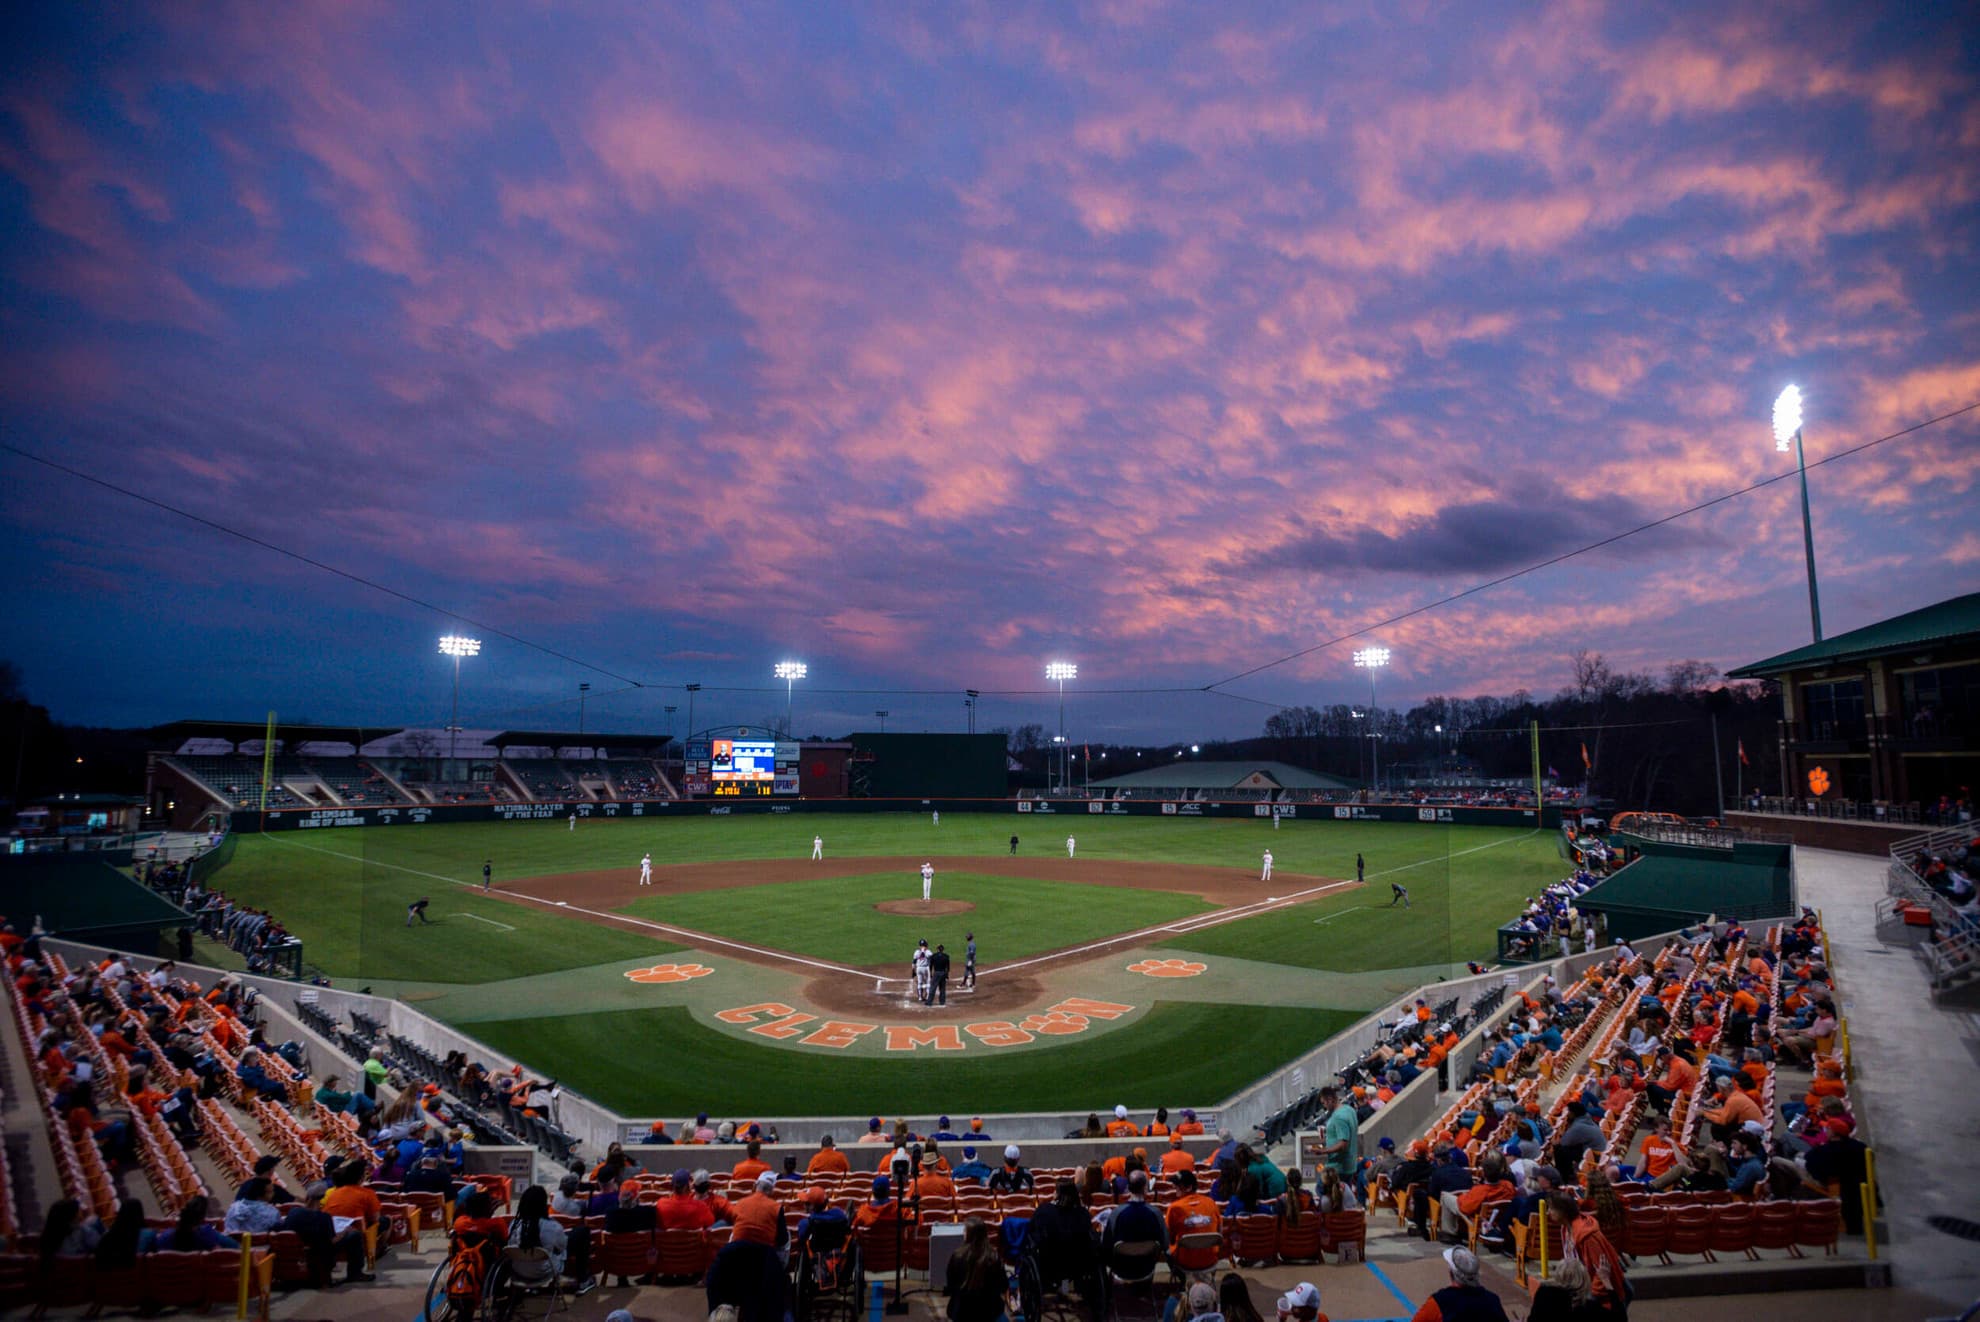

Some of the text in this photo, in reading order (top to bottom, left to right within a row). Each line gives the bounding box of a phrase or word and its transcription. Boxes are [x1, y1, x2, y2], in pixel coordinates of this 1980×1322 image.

[494, 803, 564, 812] NATIONAL PLAYER
[1273, 804, 1296, 814] CWS
[516, 811, 531, 819] THE
